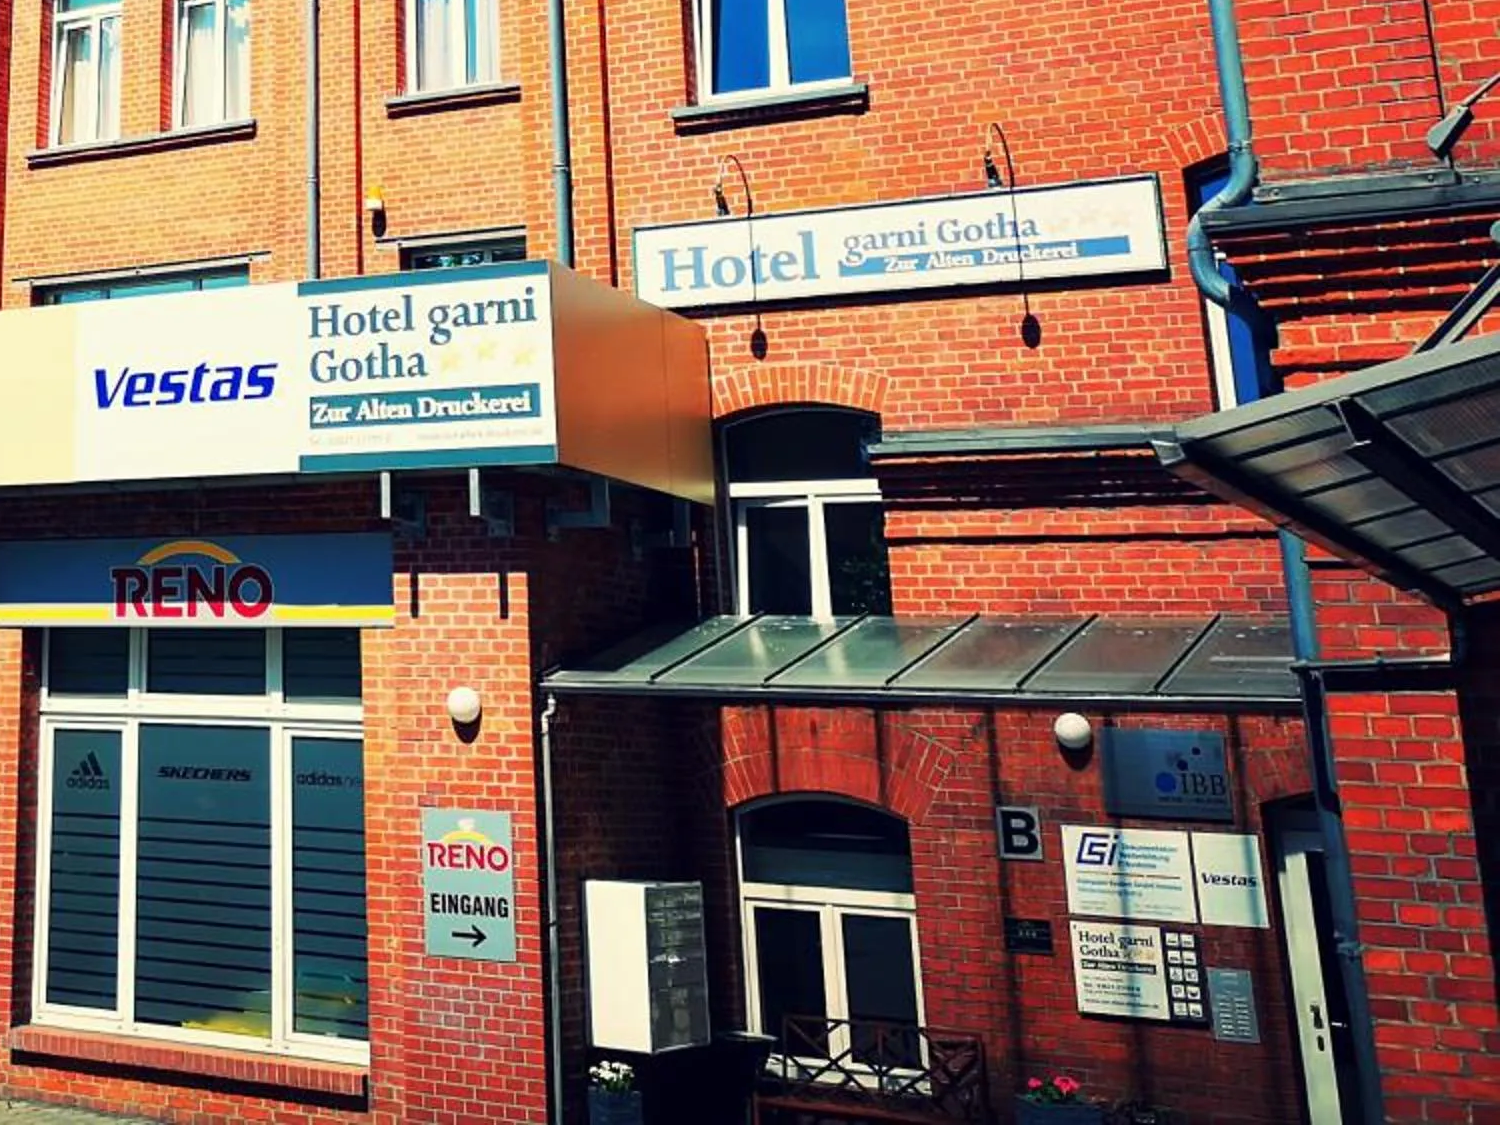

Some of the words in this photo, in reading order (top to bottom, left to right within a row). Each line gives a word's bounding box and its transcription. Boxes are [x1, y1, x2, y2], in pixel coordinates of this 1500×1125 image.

[843, 220, 928, 265] garni
[937, 212, 1040, 245] Gotha
[659, 230, 820, 293] Hotel
[884, 255, 918, 274] Zur
[925, 250, 975, 271] Alten
[981, 242, 1079, 265] Druckerei
[308, 294, 415, 339] Hotel
[427, 286, 538, 345] garni
[309, 342, 429, 384] Gotha
[94, 362, 278, 409] Vestas
[312, 402, 352, 424] Zur
[356, 397, 413, 422] Alten
[417, 391, 532, 418] Druckerei
[110, 563, 273, 619] RENO
[66, 775, 110, 791] adidas
[157, 765, 253, 782] SKECHERS
[296, 772, 342, 787] adidas
[1002, 810, 1039, 855] B
[427, 842, 509, 873] RENO
[1201, 871, 1257, 888] Vestas
[430, 892, 508, 919] EINGANG
[1079, 930, 1115, 944] Hotel
[1080, 944, 1119, 959] Gotha
